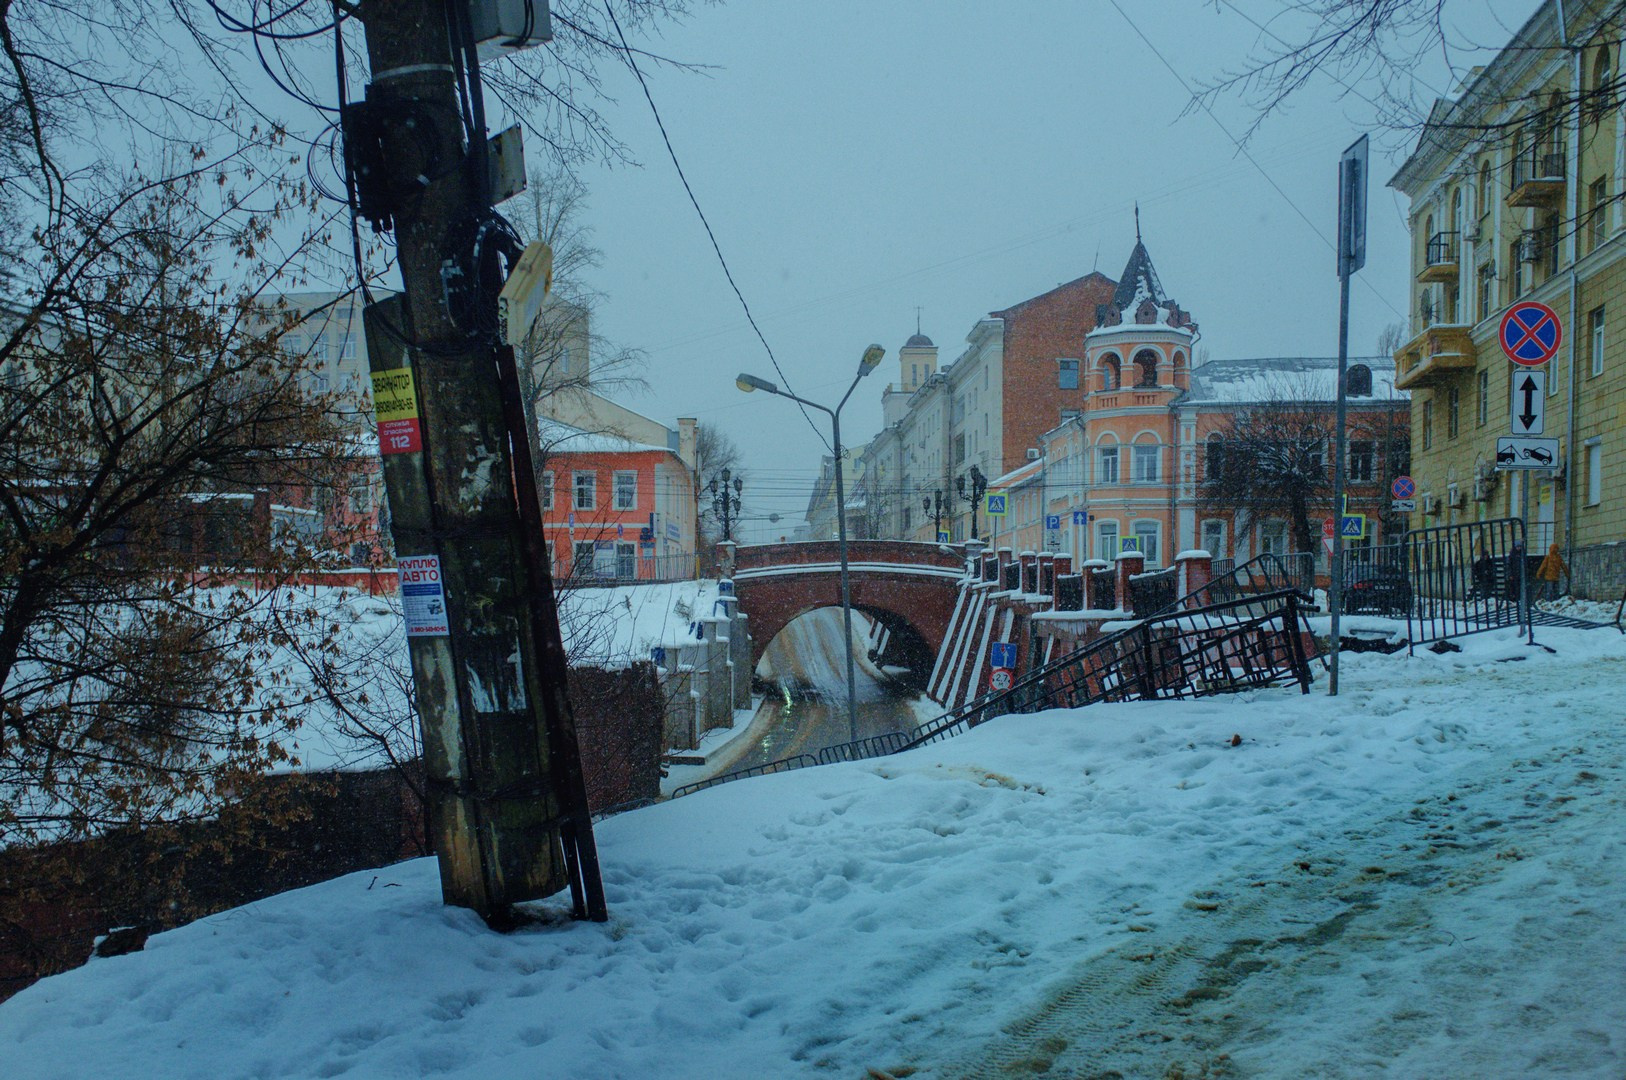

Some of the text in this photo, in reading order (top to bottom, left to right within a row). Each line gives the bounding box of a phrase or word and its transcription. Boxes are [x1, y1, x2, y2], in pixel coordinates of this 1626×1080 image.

[390, 435, 411, 448] 112
[1050, 517, 1057, 528] P
[399, 559, 438, 569] КУПЛЮ
[402, 570, 439, 582] АВТО
